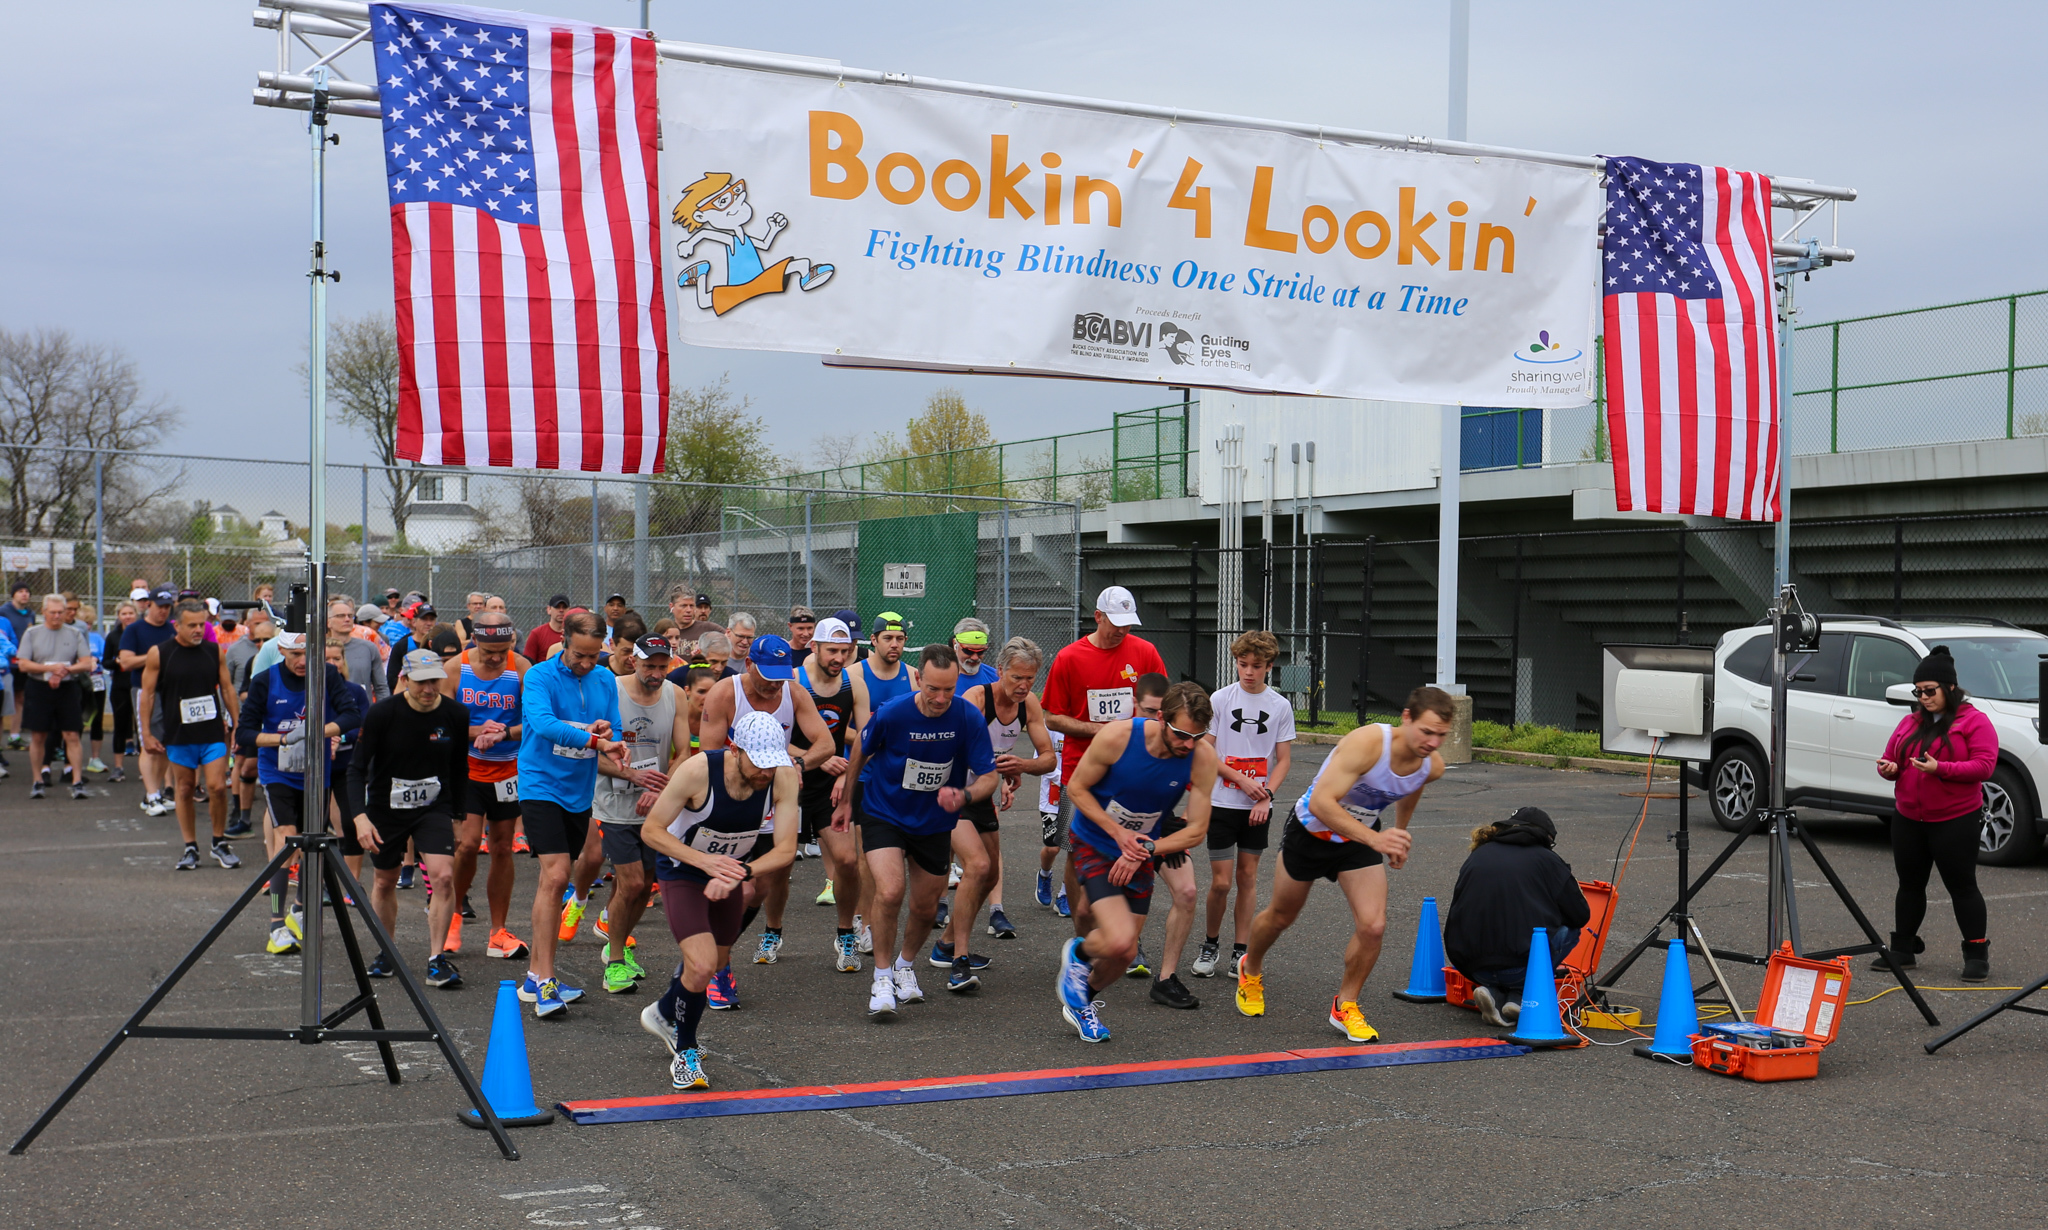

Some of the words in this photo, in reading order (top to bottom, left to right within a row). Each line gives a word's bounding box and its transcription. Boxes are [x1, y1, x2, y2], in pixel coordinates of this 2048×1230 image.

[810, 111, 1142, 228] Bookin'
[1167, 157, 1212, 239] 4
[1245, 166, 1537, 273] Lookin'
[863, 229, 1006, 278] Fighting
[1017, 244, 1161, 286] Blindness
[1172, 260, 1236, 292] One
[1242, 267, 1326, 304] Stride
[1332, 286, 1361, 309] at
[1367, 291, 1386, 311] a
[1400, 284, 1469, 317] Time
[1135, 306, 1170, 318] Proceeds
[1172, 310, 1202, 321] Benefit
[1072, 312, 1152, 349] BCABVI
[1201, 334, 1250, 351] Guiding
[1103, 353, 1125, 361] VISUALLY
[1106, 347, 1137, 356] ASSOCIATION
[1201, 346, 1231, 359] Eyes
[1201, 358, 1213, 367] for
[1215, 359, 1229, 368] the
[1230, 360, 1251, 371] Blind
[1506, 385, 1538, 396] Proudly
[1540, 384, 1581, 395] Managed
[900, 571, 910, 580] NO
[886, 581, 924, 590] TAILGATING
[462, 687, 516, 710] BCRR
[189, 705, 207, 717] 821
[1098, 699, 1121, 715] 812
[909, 731, 936, 740] TEAM
[938, 731, 956, 739] TCS
[917, 771, 943, 785] 855
[505, 780, 518, 796] 81
[402, 789, 428, 803] 814
[1118, 816, 1144, 831] 768
[707, 841, 738, 855] 841
